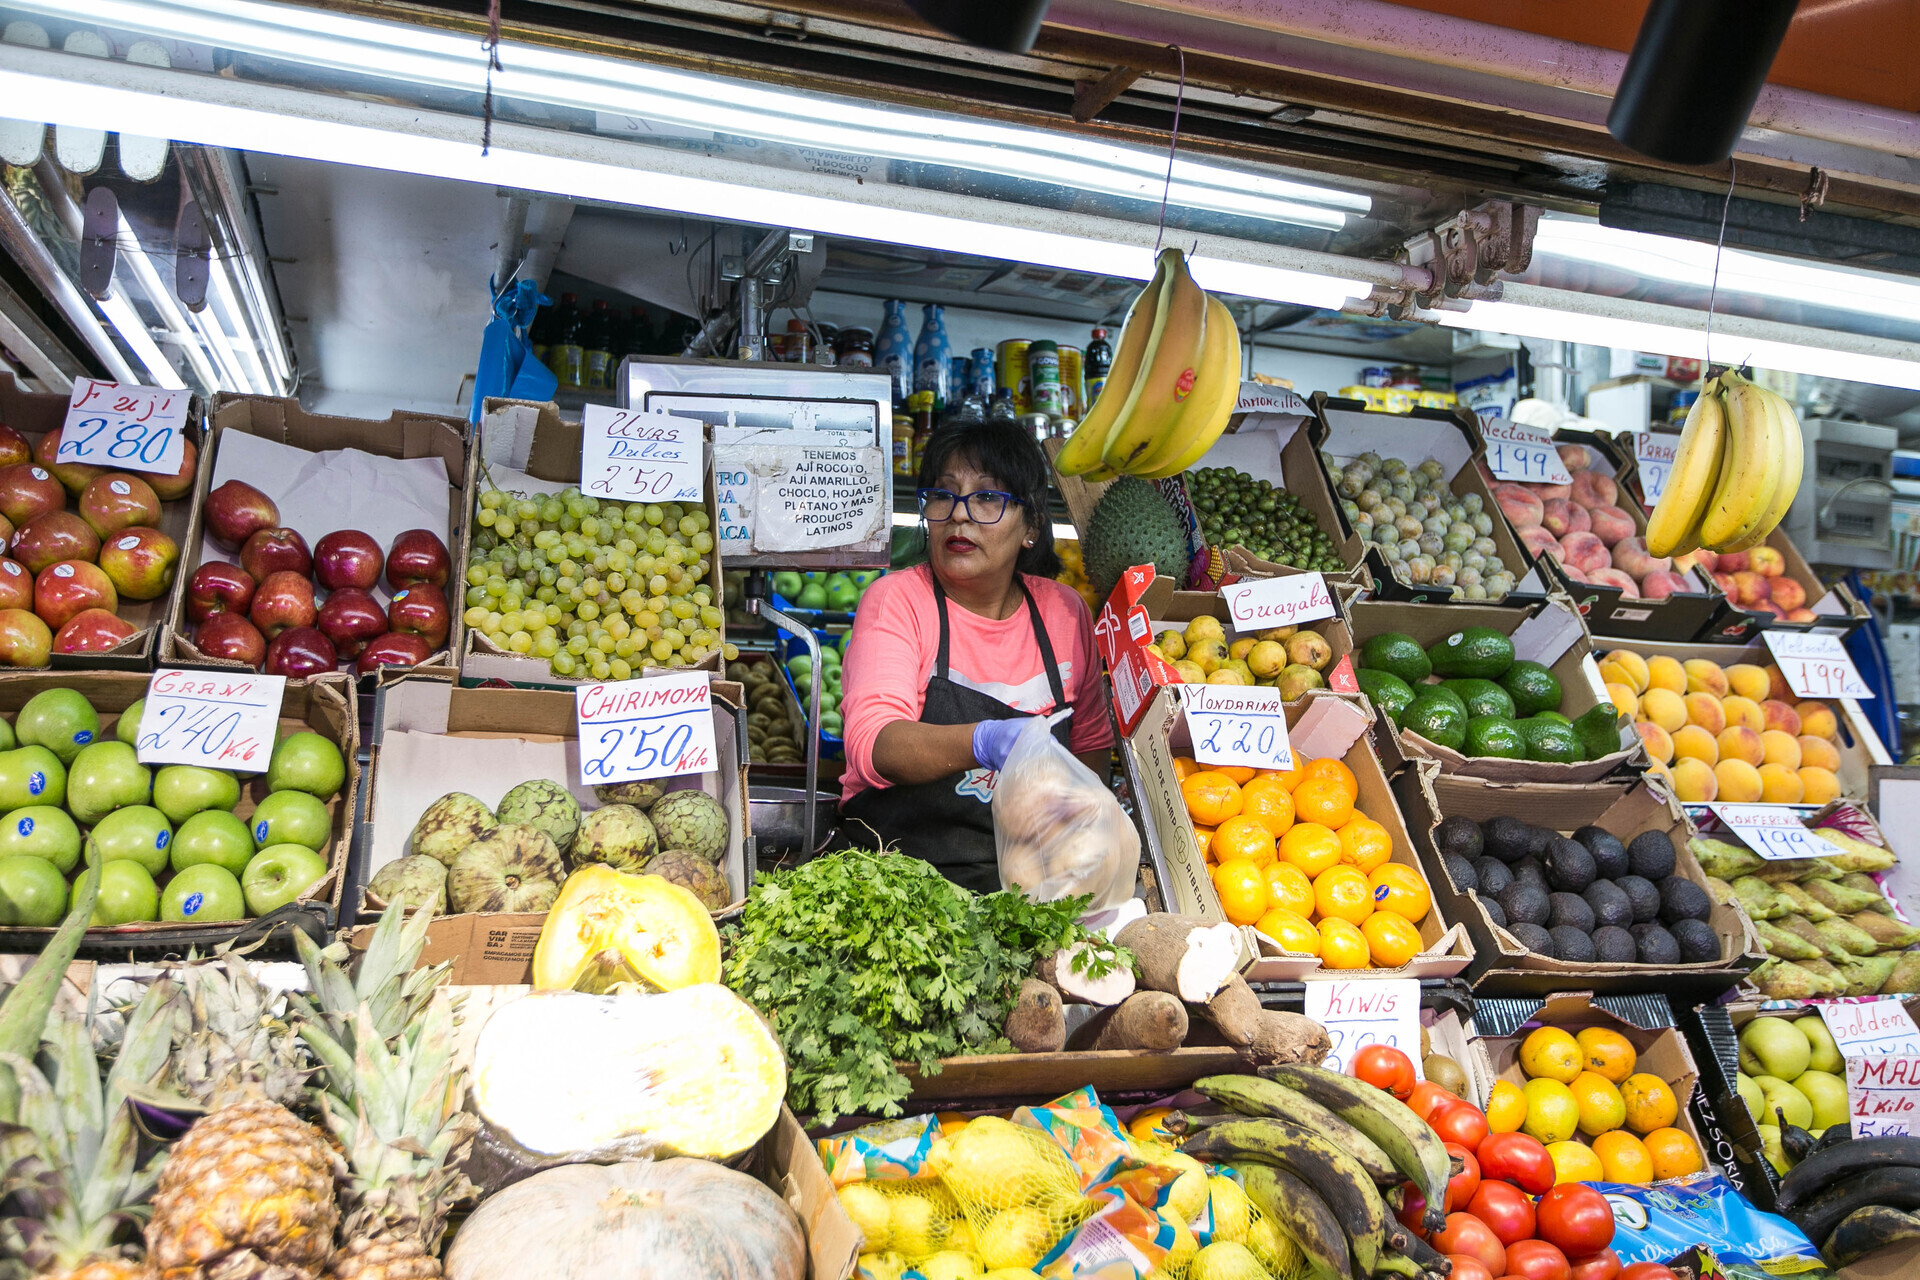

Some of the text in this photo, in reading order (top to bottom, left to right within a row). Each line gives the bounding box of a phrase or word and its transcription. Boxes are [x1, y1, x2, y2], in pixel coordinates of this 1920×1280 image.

[72, 381, 176, 422] Fuji
[608, 440, 682, 459] Dulces
[803, 450, 857, 461] TENEMOS
[795, 461, 868, 475] AJÍ ROCOTO,
[789, 474, 807, 485] AJÍ
[778, 484, 880, 500] CHOCLO, HOJA DE
[784, 495, 874, 511] PLATANO Y MÁS
[795, 508, 864, 524] PRODUCTOS
[806, 521, 853, 536] LATINOS
[1233, 582, 1331, 621] Guayaba
[580, 684, 708, 718] CHIRIMOYA
[674, 746, 709, 773] Kilo
[1148, 734, 1160, 767] FLOR
[1158, 770, 1166, 787] DE
[1186, 862, 1207, 915] RIBERA
[1826, 1005, 1907, 1039] Golden
[1853, 1090, 1915, 1116] 1 Kilo
[1859, 1121, 1876, 1137] 5
[1710, 1127, 1744, 1192] SORIA
